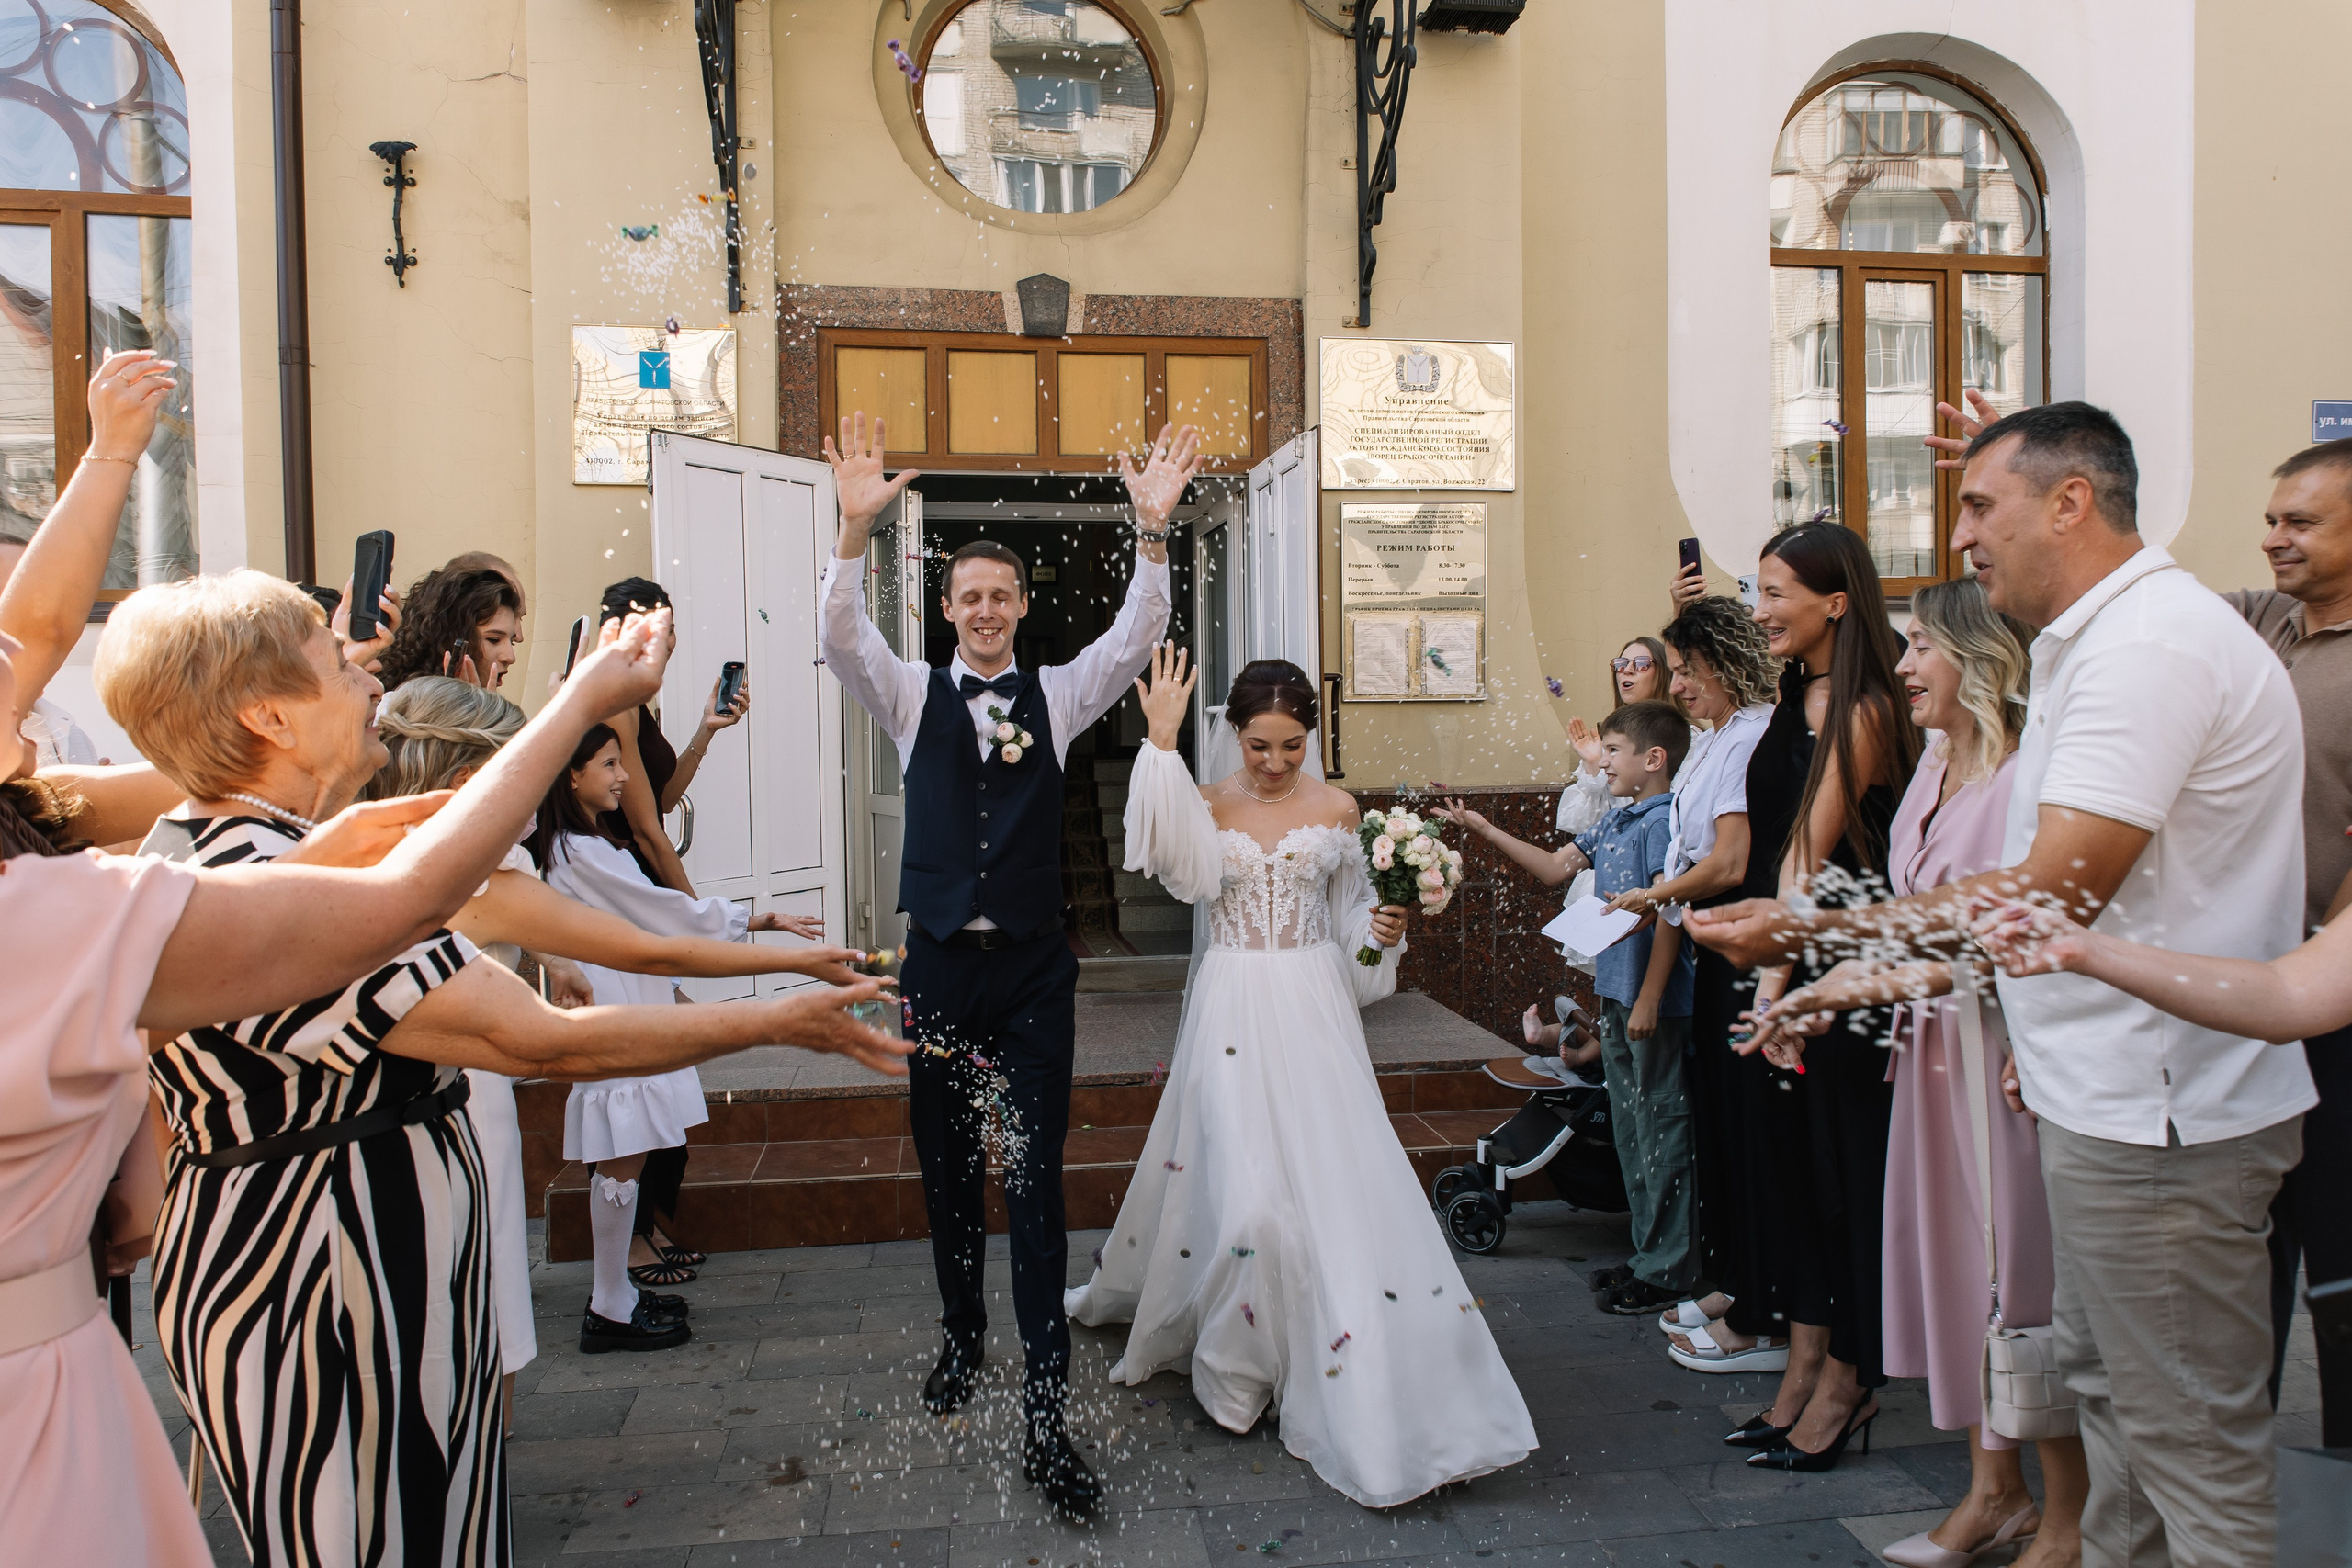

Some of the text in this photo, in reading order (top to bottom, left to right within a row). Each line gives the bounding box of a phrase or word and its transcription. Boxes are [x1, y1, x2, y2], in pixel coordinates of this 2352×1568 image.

[1385, 396, 1449, 407] Управление
[597, 412, 645, 421] Управление
[2319, 417, 2337, 428] ул.
